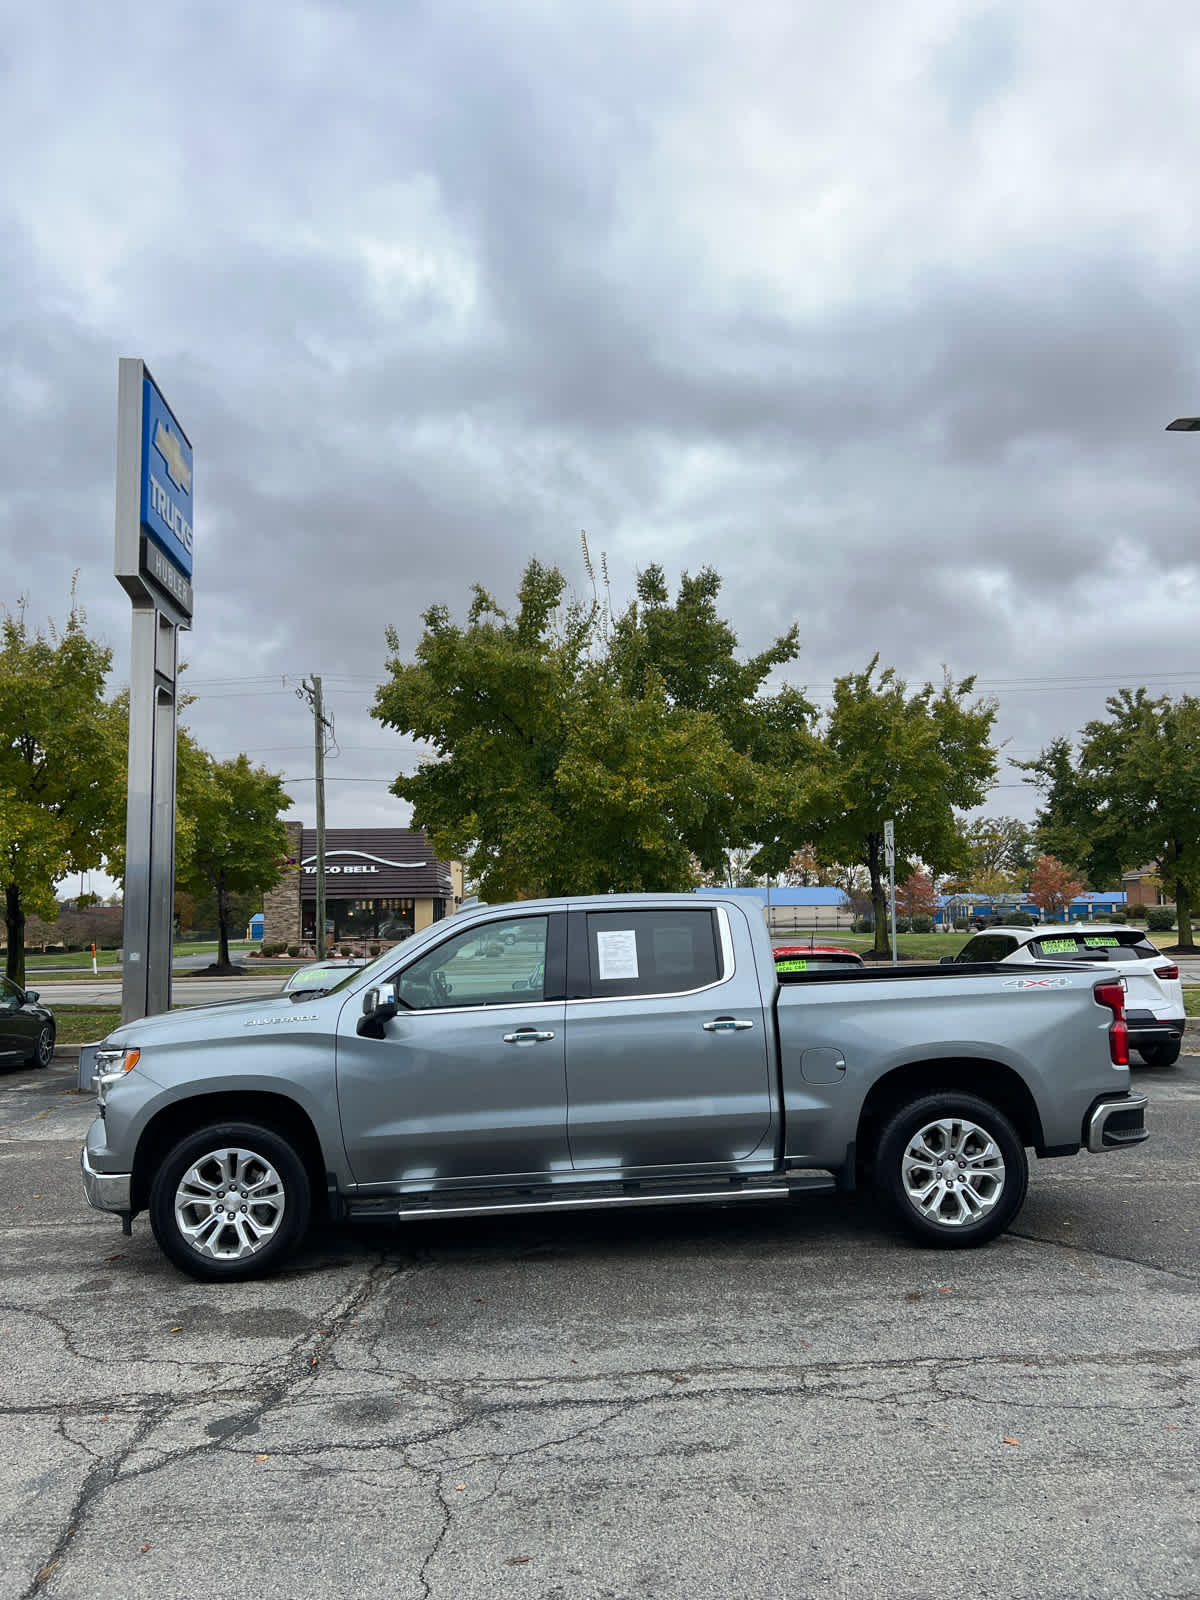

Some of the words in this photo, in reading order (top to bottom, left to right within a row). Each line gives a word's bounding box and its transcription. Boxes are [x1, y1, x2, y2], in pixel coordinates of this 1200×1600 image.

[150, 473, 193, 555] TRUCKS
[155, 552, 189, 606] HUBLER
[343, 865, 380, 873] BELL
[243, 1015, 320, 1026] SILVERADO
